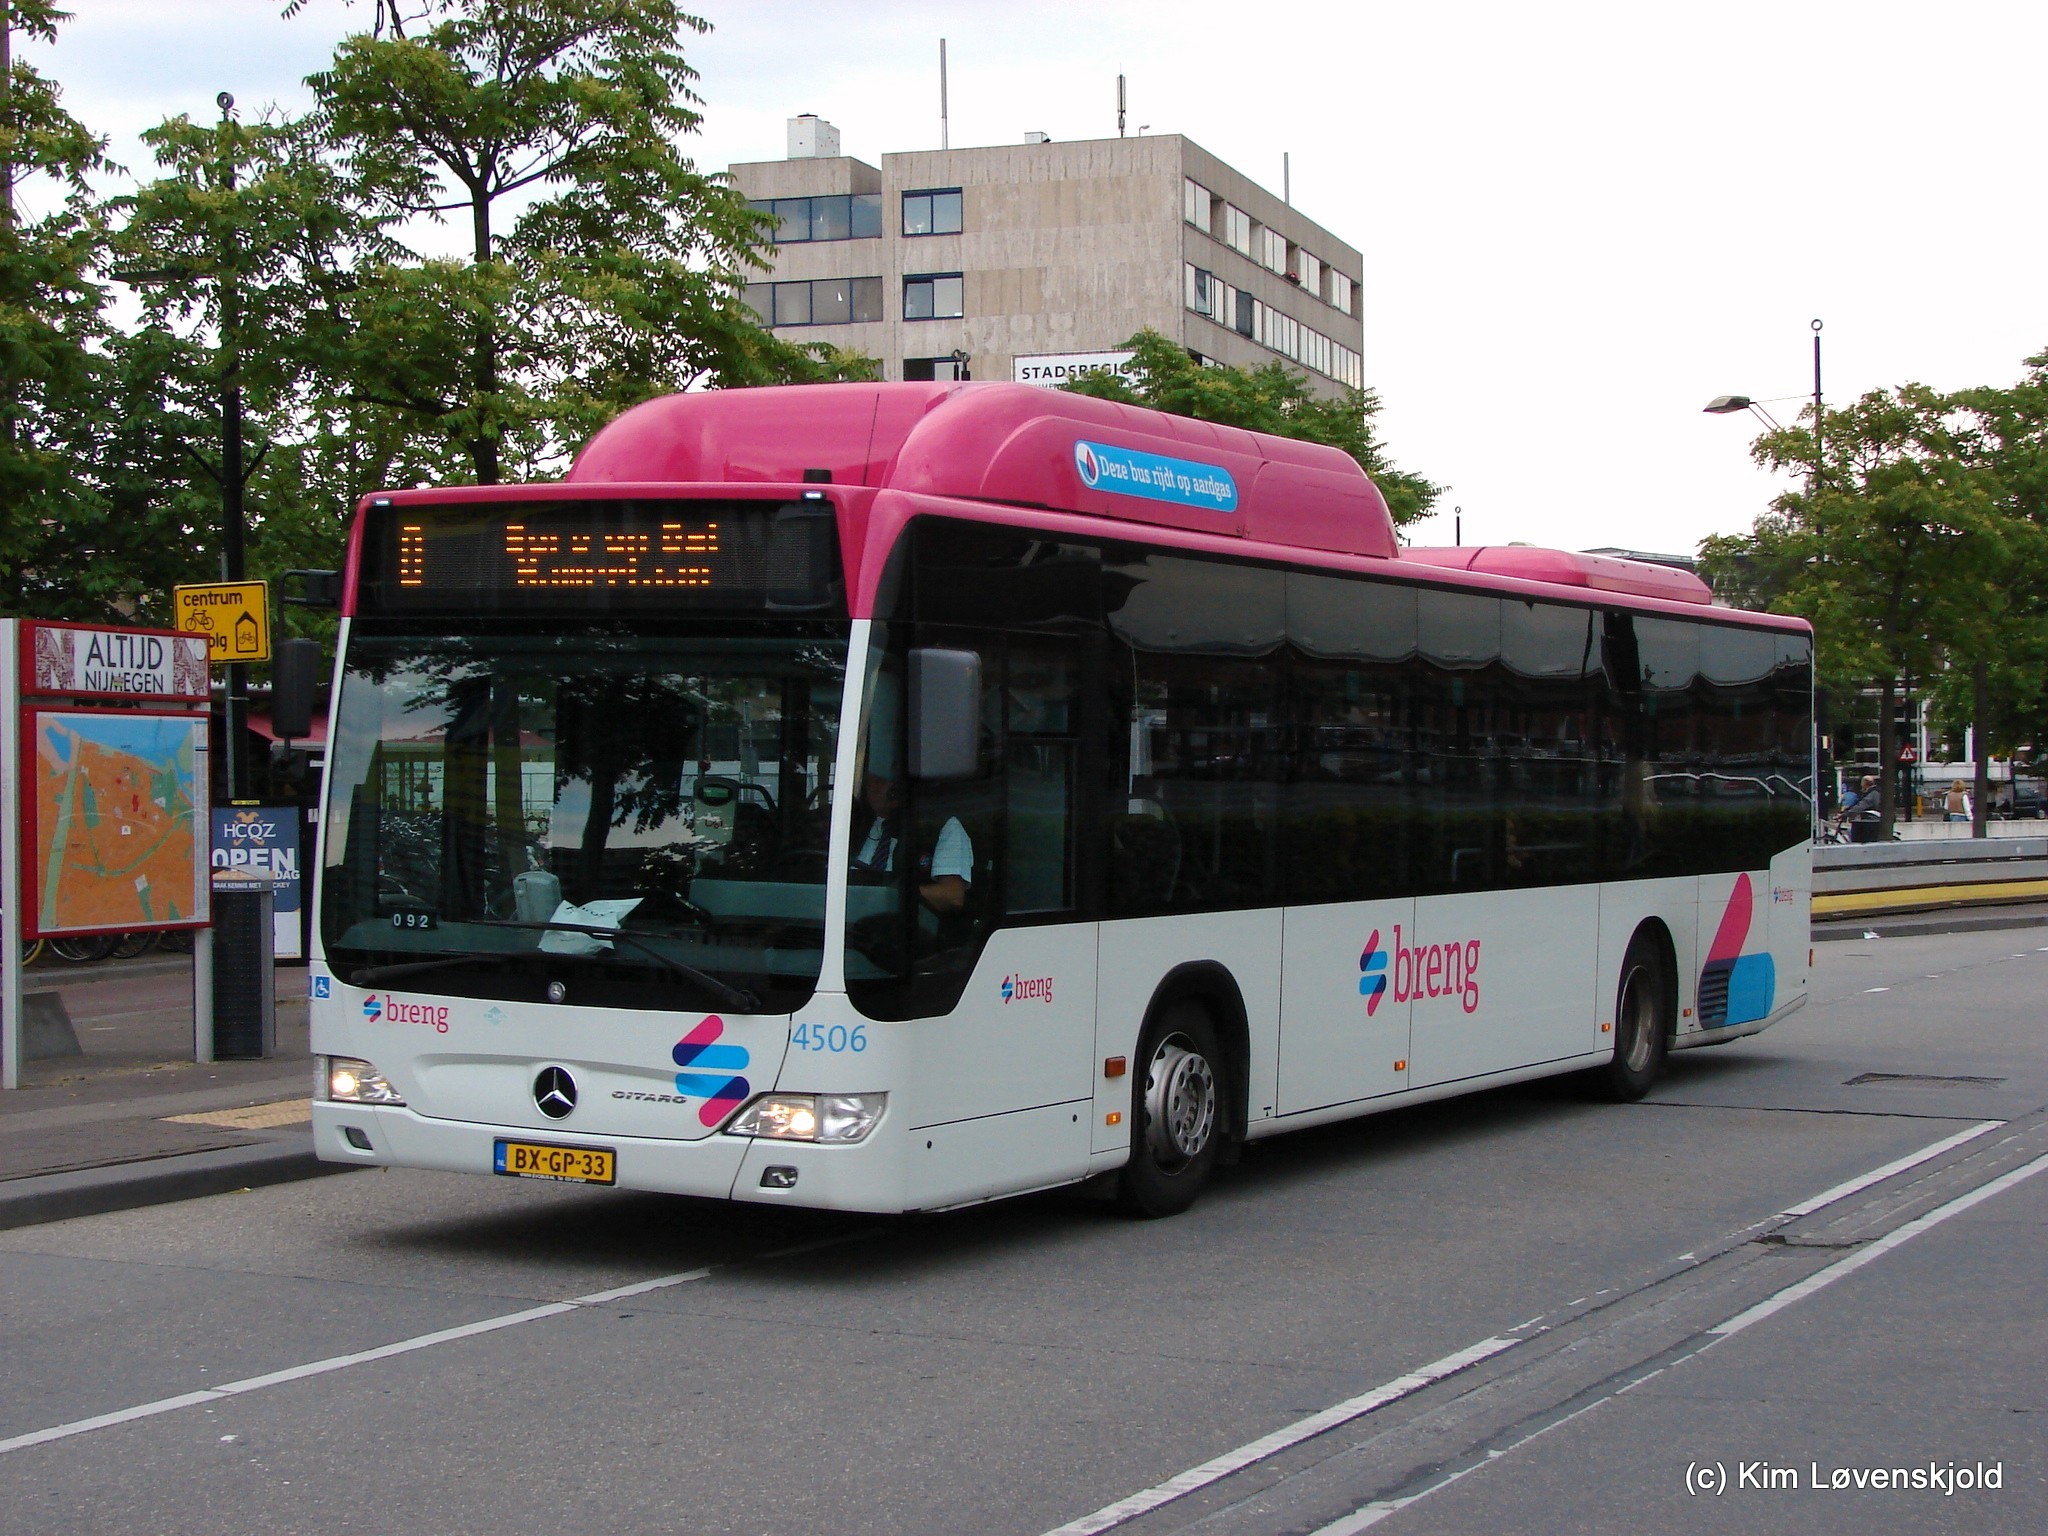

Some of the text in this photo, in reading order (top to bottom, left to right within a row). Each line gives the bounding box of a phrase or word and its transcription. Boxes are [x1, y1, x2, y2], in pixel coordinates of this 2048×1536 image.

[1098, 455, 1232, 502] Deze bus rijdt op aardgas
[183, 591, 243, 606] centrum
[86, 634, 163, 670] ALTIJD
[209, 632, 228, 652] olg
[85, 670, 164, 693] NIJMEGEN
[212, 848, 295, 872] OPEN
[393, 913, 429, 928] 092
[1393, 924, 1481, 1014] breng
[1015, 973, 1053, 1003] breng
[385, 994, 449, 1033] breng
[792, 1024, 867, 1053] 4506
[612, 1091, 687, 1104] CITARO
[515, 1148, 605, 1176] BX-GP-33
